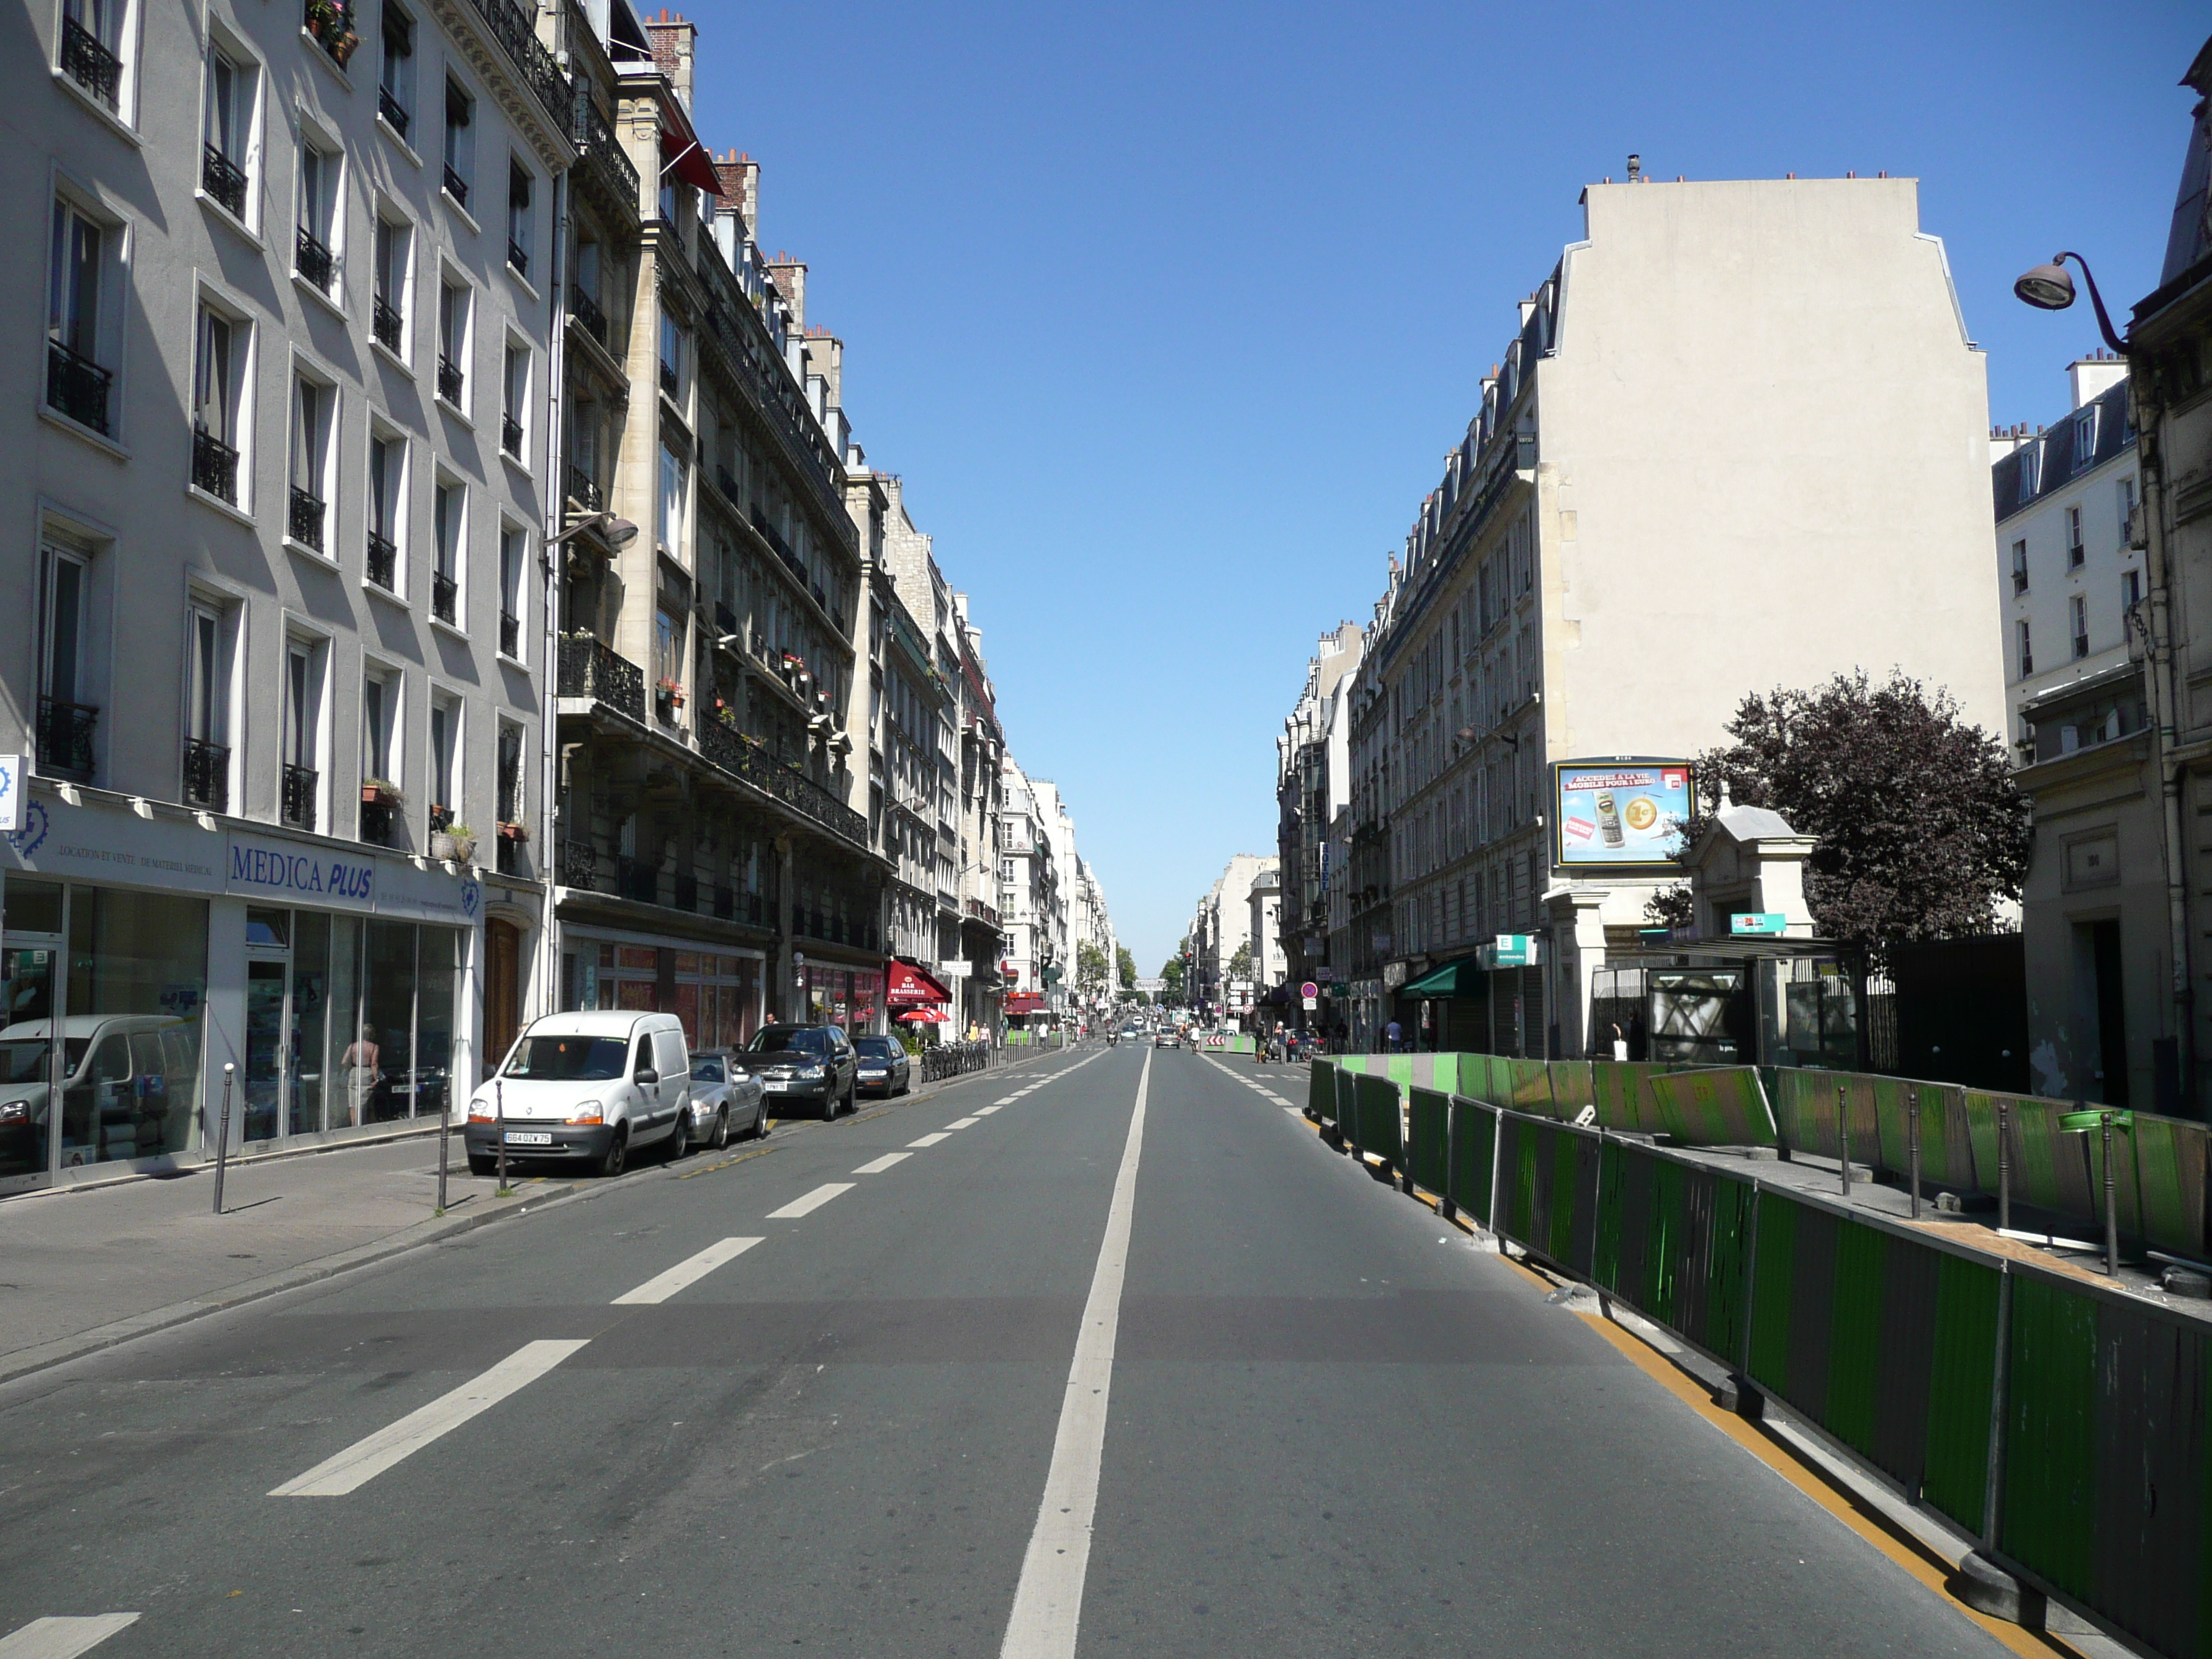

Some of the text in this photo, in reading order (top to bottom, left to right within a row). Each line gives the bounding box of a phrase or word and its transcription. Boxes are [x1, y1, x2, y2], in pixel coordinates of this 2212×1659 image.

[1568, 781, 1604, 789] MOBILE
[60, 845, 99, 859] LOCATION
[102, 851, 110, 861] ET
[112, 853, 135, 864] VENTE
[141, 857, 150, 867] DE
[231, 846, 372, 899] MEDICA PLUS
[1501, 938, 1509, 948] E
[508, 1133, 522, 1142] 664
